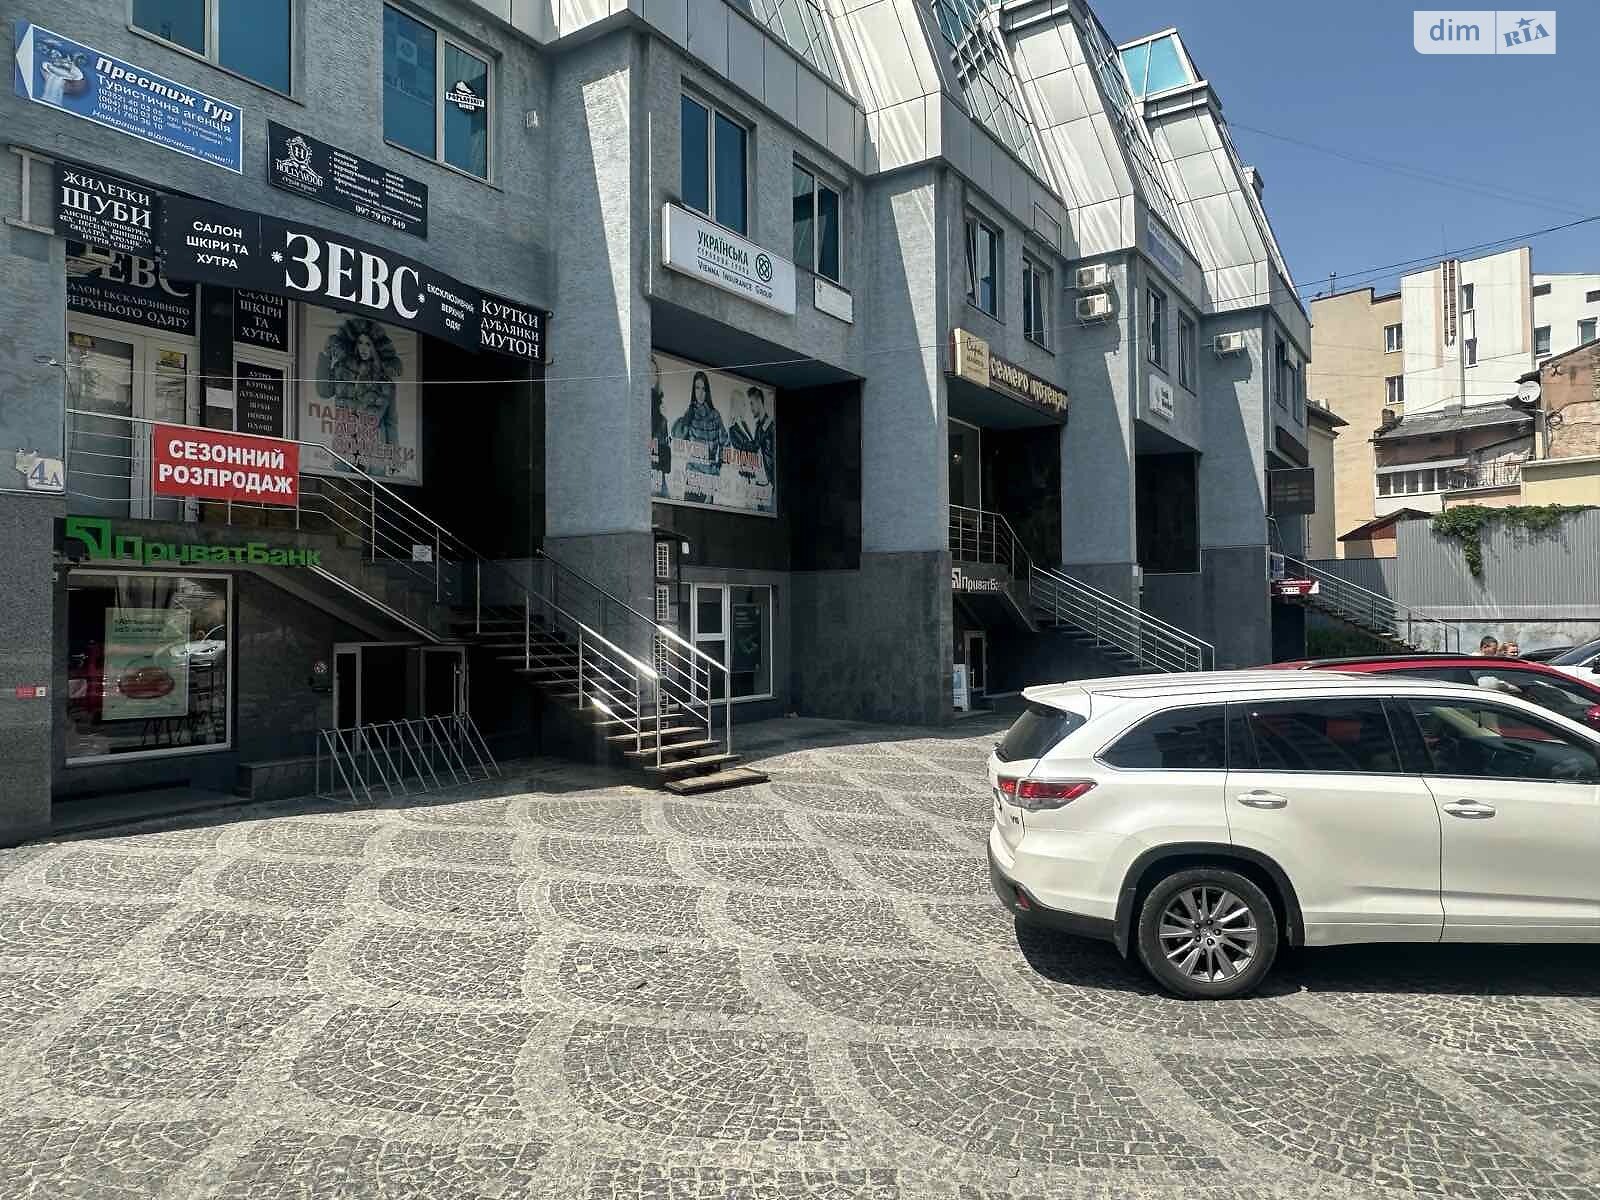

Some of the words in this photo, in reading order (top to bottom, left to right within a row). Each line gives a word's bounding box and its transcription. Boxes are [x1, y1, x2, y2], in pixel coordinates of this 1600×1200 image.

[96, 57, 196, 107] Престиж
[203, 98, 233, 123] Тур
[96, 73, 180, 114] Туристична
[183, 110, 232, 134] агенція
[64, 170, 150, 206] ЖИЛЕТКИ
[275, 160, 323, 187] HOLLYWOOD
[61, 186, 151, 229] ШУБИ
[192, 221, 242, 238] САЛОН
[186, 235, 230, 252] ШКІРИ
[233, 244, 249, 256] ТА
[697, 230, 750, 267] УКРАЇНСЬКА
[196, 253, 238, 269] ХУТРА
[285, 231, 419, 320] ЗЕВС
[147, 310, 191, 328] ОДЯГУ
[240, 301, 282, 319] ШКІРИ
[255, 315, 269, 329] ТА
[481, 299, 539, 329] КУРТКИ
[241, 327, 281, 344] ХУТРА
[480, 317, 540, 343] ДУБЛЯНКИ
[480, 329, 540, 359] МУТОН
[168, 439, 285, 470] СЕЗОННИЙ
[159, 463, 293, 495] РОЗПРОДАЖ
[114, 534, 321, 566] ПриватБанк
[962, 575, 1003, 593] ПриватБ
